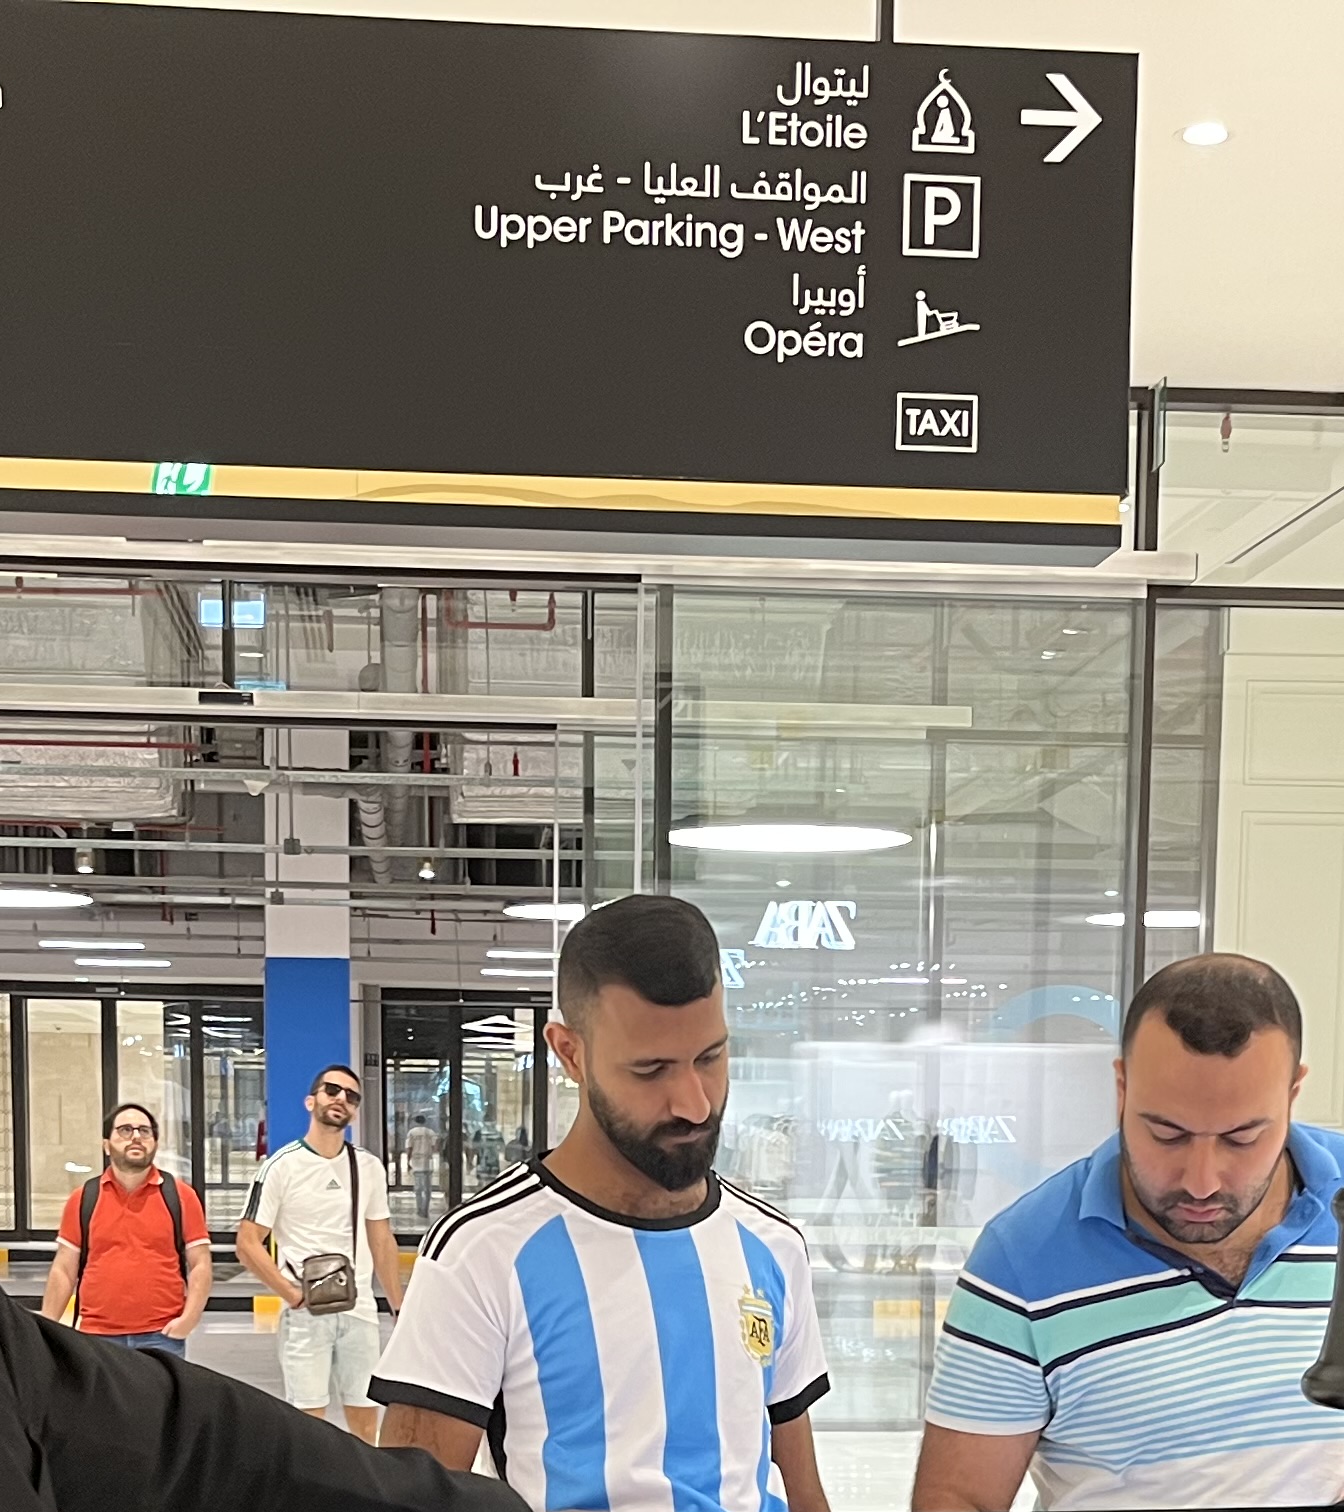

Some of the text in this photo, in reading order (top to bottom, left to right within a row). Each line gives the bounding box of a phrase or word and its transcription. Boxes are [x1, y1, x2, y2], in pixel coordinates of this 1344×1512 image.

[776, 61, 870, 107] ليتوال
[741, 111, 869, 151] L'Etoile
[534, 163, 605, 202] غرب
[643, 161, 721, 205] العليا
[729, 169, 868, 211] المواقف
[473, 205, 590, 248] Upper
[602, 209, 744, 259] Parking
[775, 217, 866, 254] West
[924, 186, 961, 246] P
[791, 263, 867, 316] أوبيرا
[743, 320, 864, 363] Opéra
[905, 407, 970, 438] TAXI
